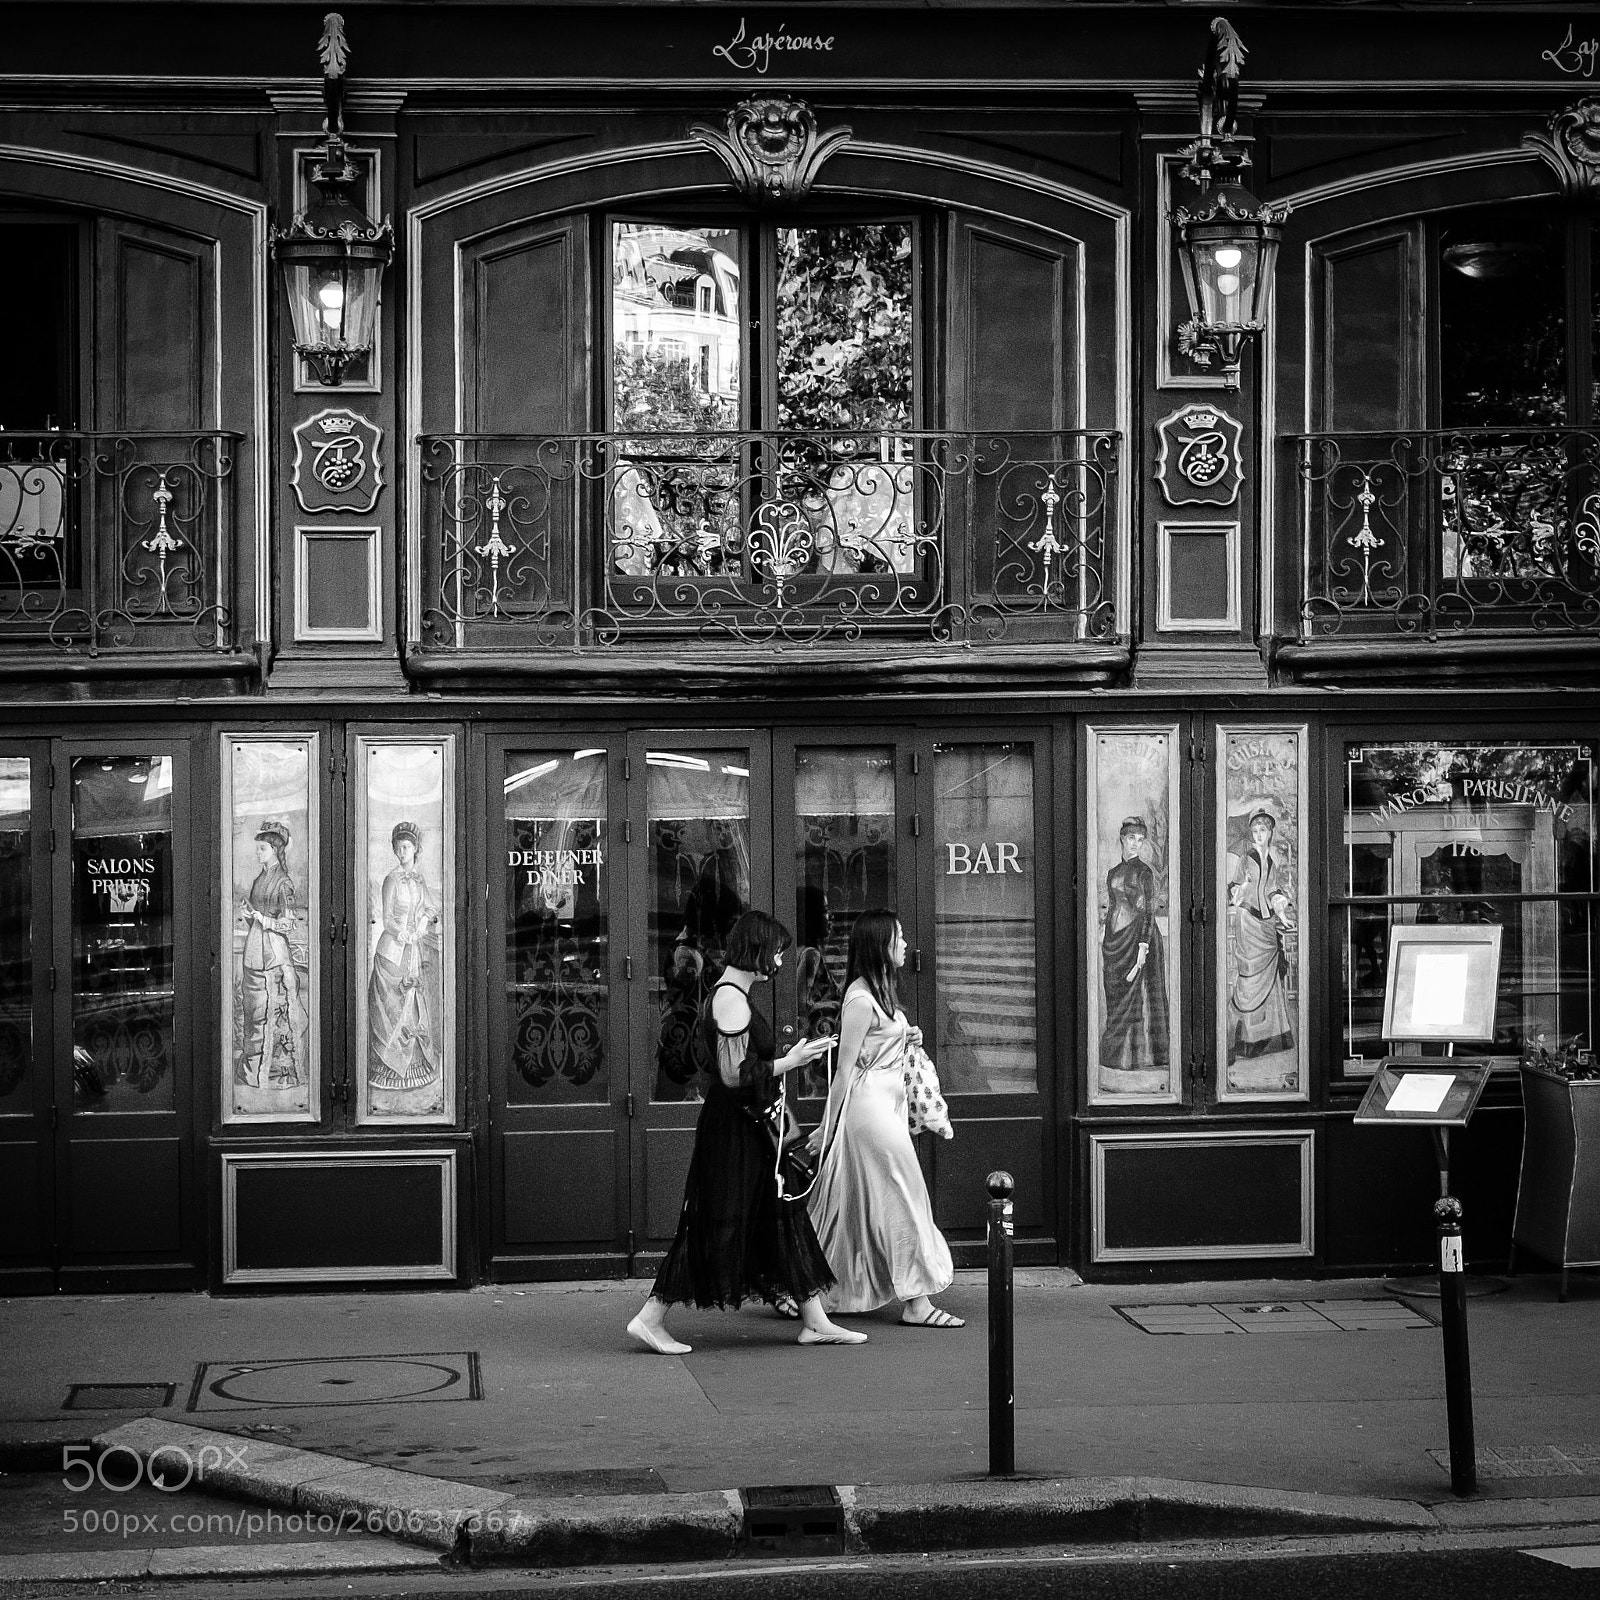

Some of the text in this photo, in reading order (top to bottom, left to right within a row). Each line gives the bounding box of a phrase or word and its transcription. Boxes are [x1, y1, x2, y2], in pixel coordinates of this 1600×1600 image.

[712, 17, 835, 73] Lapérouse
[1369, 778, 1574, 827] MAISON PARISIENNE
[87, 858, 155, 874] SALONS
[508, 849, 604, 867] DEJEUNER
[945, 842, 1023, 874] BAR
